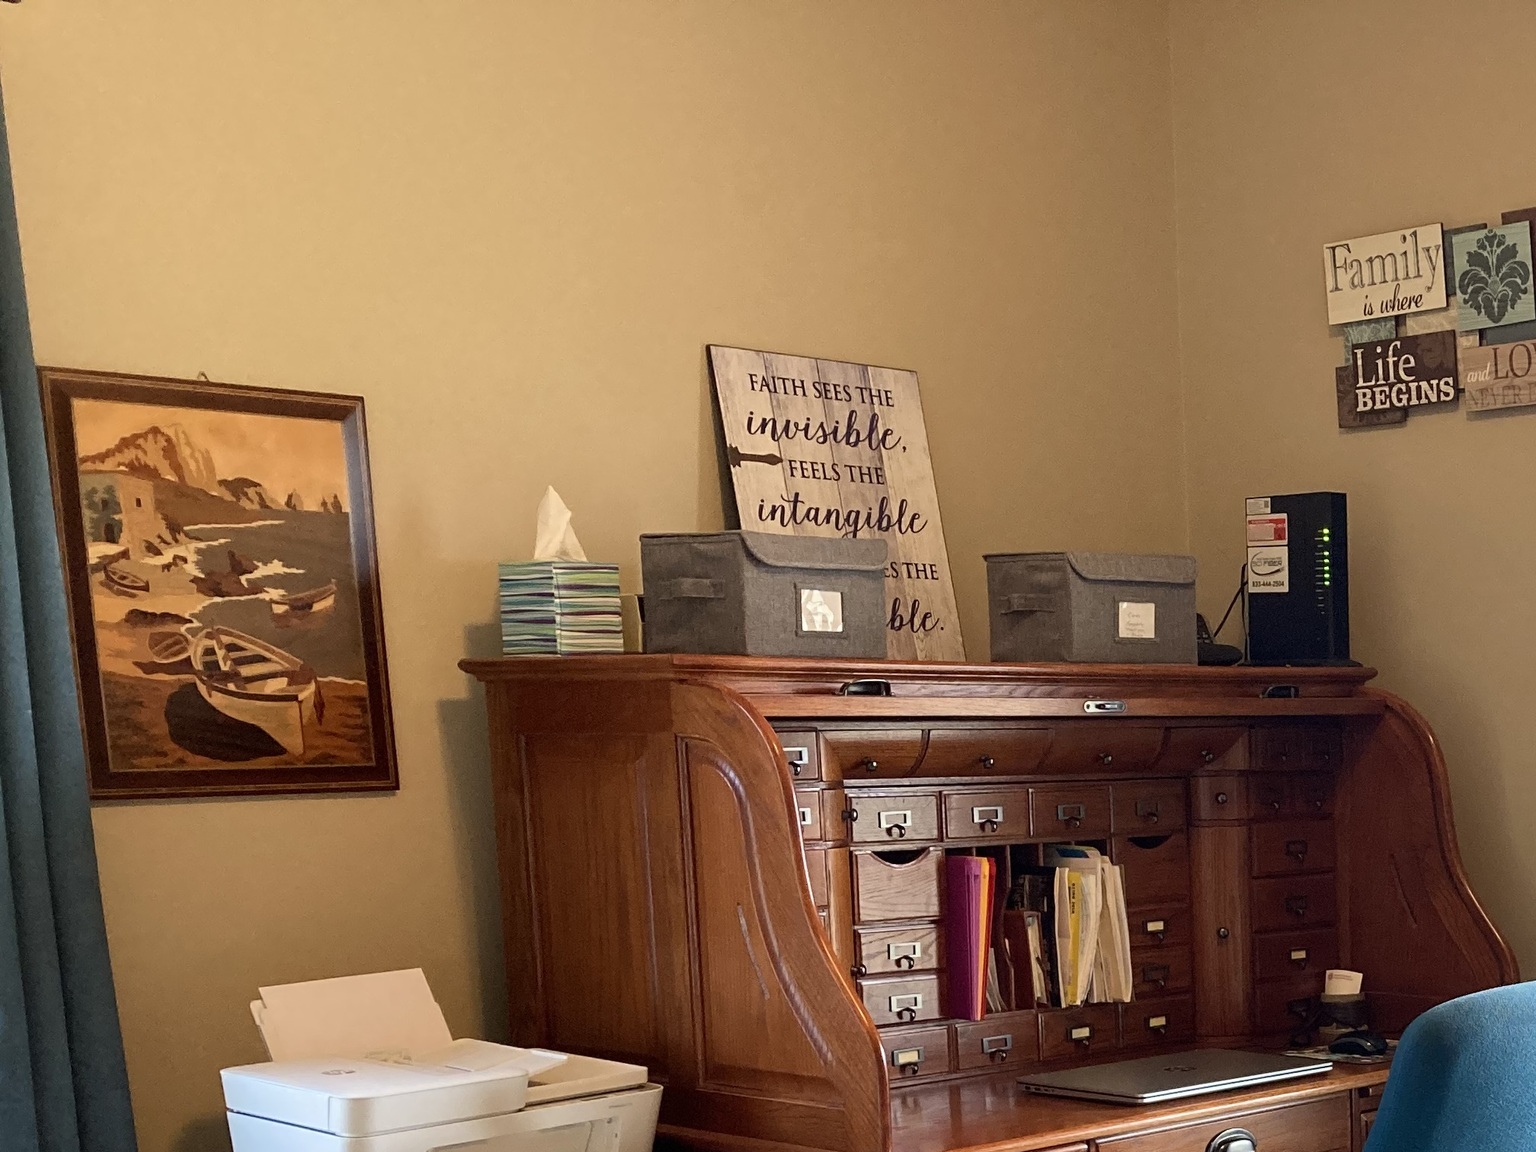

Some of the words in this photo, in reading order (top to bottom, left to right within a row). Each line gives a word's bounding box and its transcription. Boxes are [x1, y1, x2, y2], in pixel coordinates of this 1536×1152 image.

[1325, 230, 1442, 293] Family
[1363, 295, 1376, 317] is
[1380, 284, 1424, 313] where
[1354, 341, 1416, 387] Life
[1467, 362, 1491, 383] and
[748, 373, 807, 398] FAITH
[813, 380, 852, 403] SEES
[855, 386, 895, 407] THE
[1356, 377, 1455, 412] BEGINS
[1465, 385, 1522, 407] NEVER
[747, 409, 908, 453] invisible,
[788, 459, 841, 482] FEELS
[844, 464, 885, 485] THE
[758, 492, 928, 538] intangible
[902, 562, 939, 581] THE
